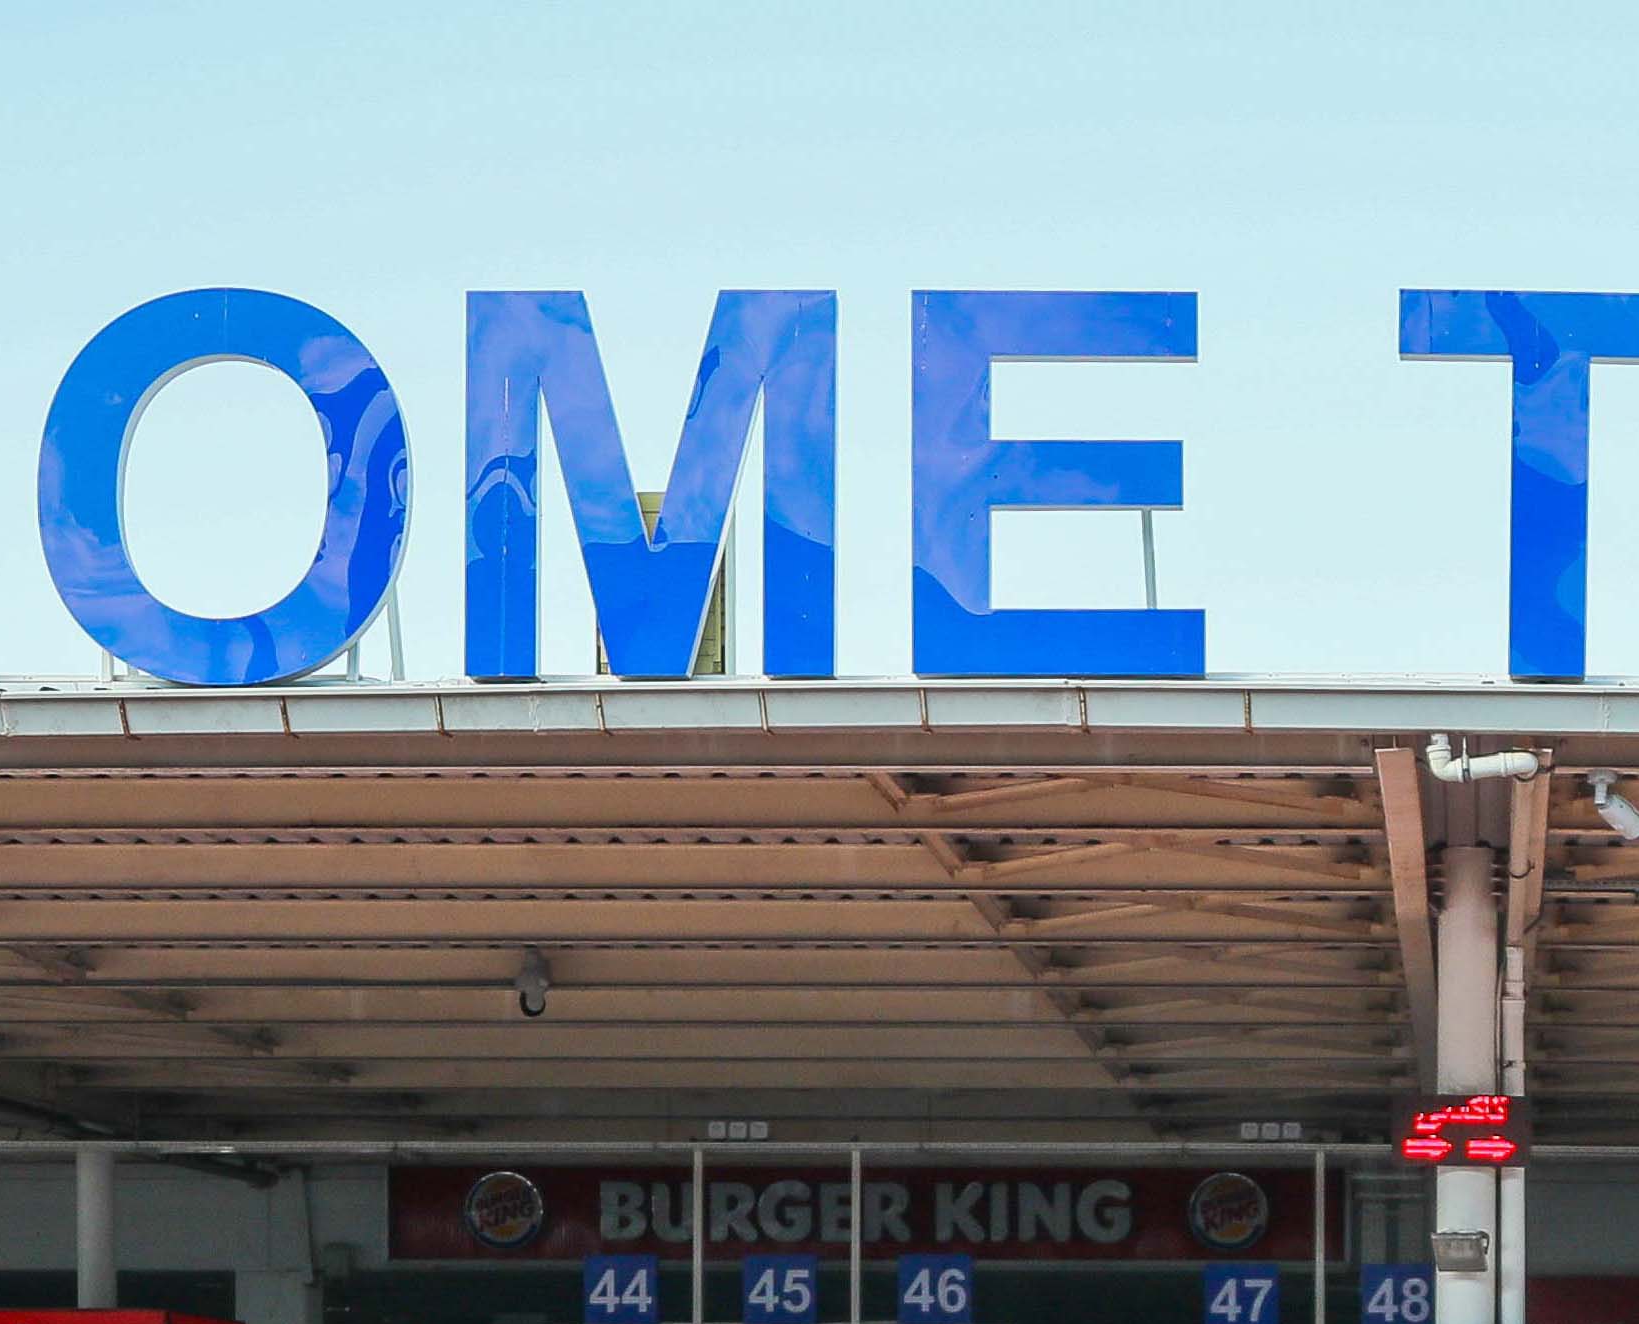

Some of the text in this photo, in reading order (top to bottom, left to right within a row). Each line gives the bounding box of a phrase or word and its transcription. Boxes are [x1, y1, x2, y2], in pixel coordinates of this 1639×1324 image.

[600, 1180, 1133, 1244] BURGER KING
[589, 1270, 653, 1313] 44
[748, 1269, 811, 1313] 45
[904, 1269, 967, 1313] 46
[1210, 1278, 1274, 1322] 47
[1367, 1278, 1430, 1322] 48
